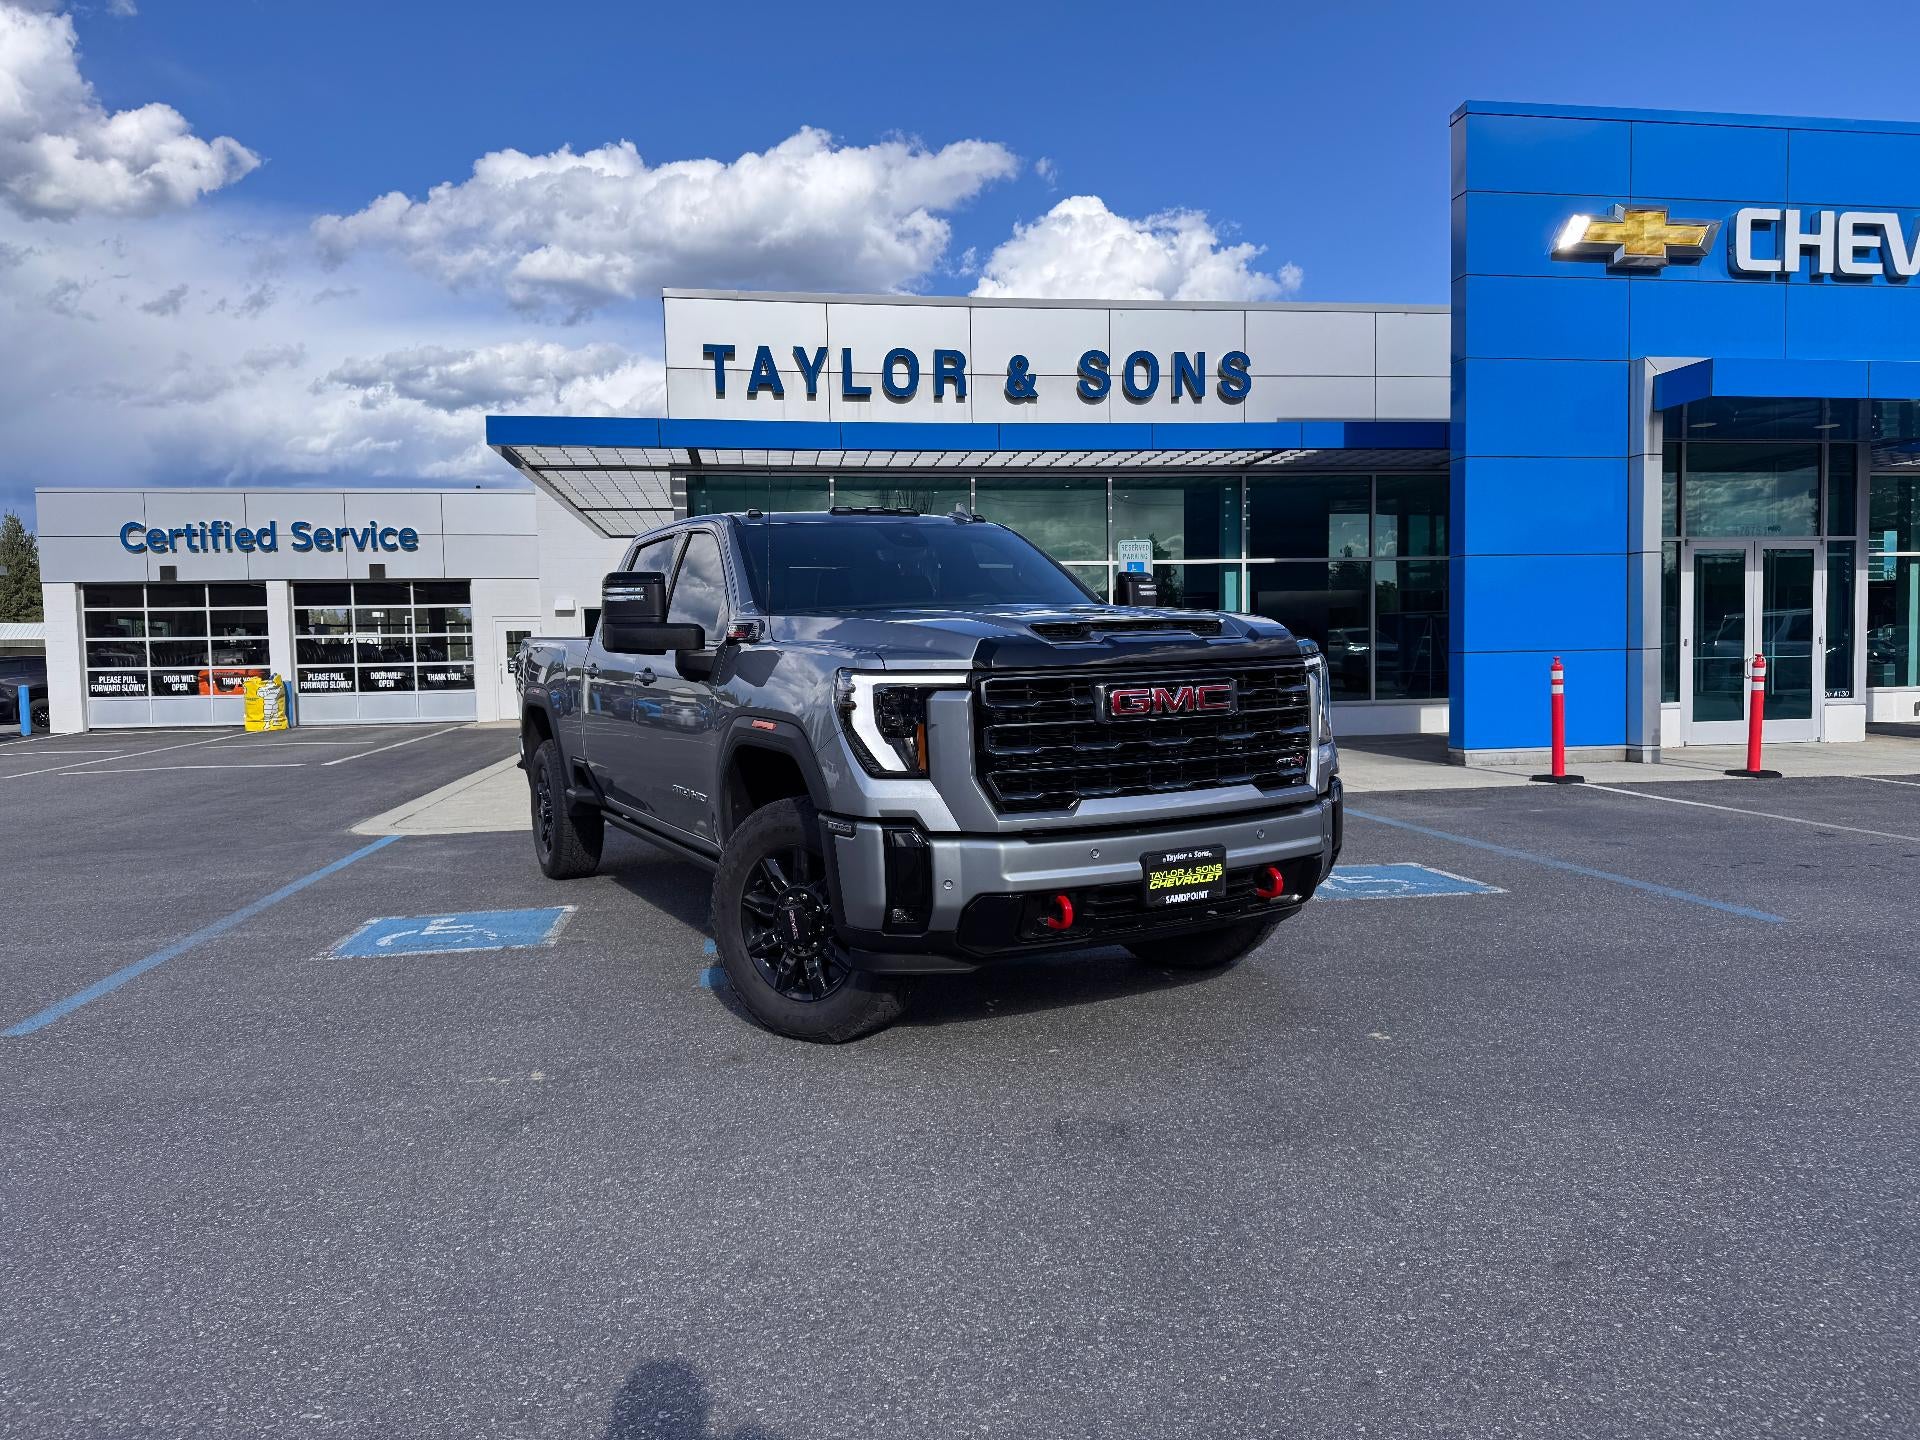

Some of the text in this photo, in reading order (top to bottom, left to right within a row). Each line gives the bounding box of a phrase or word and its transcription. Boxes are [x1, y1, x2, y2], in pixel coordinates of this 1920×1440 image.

[1732, 207, 1920, 277] CHEV
[702, 343, 1253, 404] TAYLOR & SONS
[119, 520, 419, 553] Certified Service
[99, 676, 138, 684] PLEASE PULL
[163, 675, 196, 683] DOOR WILL
[307, 673, 330, 681] PLEASE
[370, 672, 386, 680] DOOR
[426, 673, 461, 681] THANK YOU!
[222, 677, 243, 685] THANK
[300, 681, 352, 689] FORWARD SLOWLY
[378, 680, 394, 688] OPEN
[91, 684, 146, 692] FORWARD SLOWLY
[172, 683, 188, 691] OPEN
[1111, 684, 1232, 717] GMC
[1166, 852, 1188, 862] Taylor
[1194, 850, 1210, 858] Sons
[1150, 863, 1223, 880] TAYLOR & SONS
[1149, 871, 1223, 890] CHEVROLET
[1165, 889, 1209, 904] SANDPOINT
